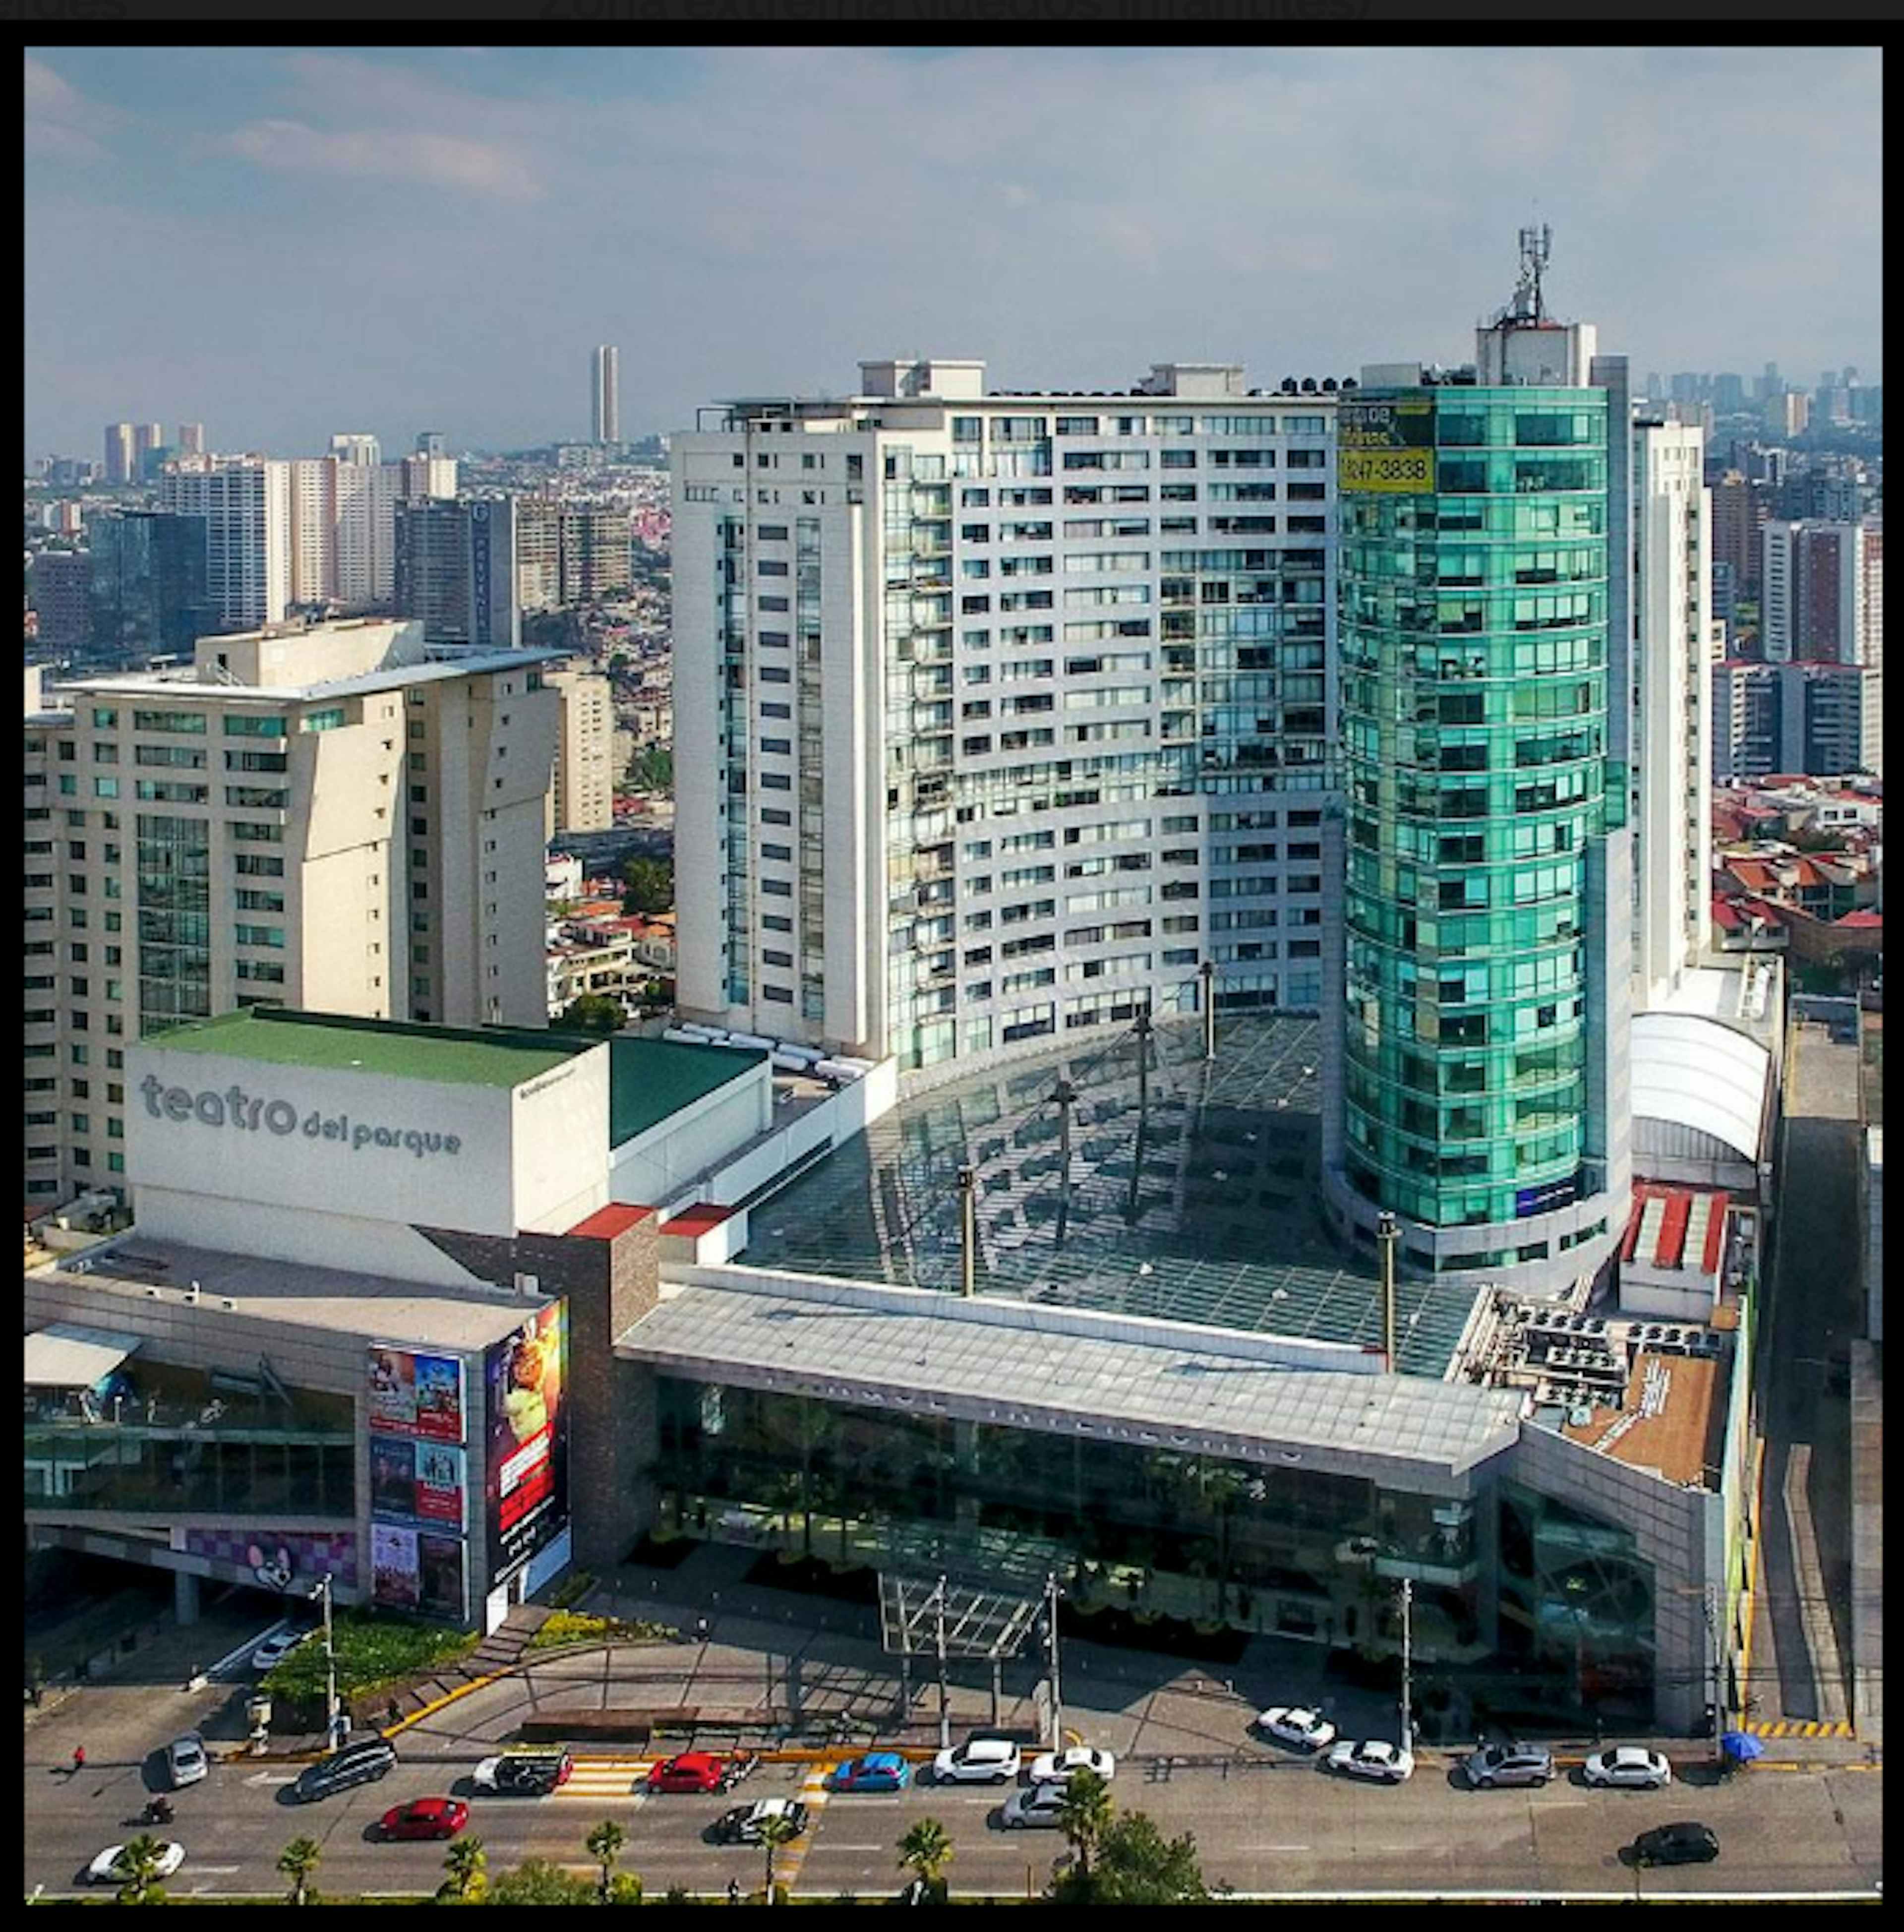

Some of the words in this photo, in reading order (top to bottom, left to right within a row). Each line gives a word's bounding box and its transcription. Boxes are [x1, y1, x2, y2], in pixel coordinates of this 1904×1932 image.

[140, 1074, 298, 1136] teatro
[302, 1111, 348, 1142] del
[353, 1124, 461, 1158] parque
